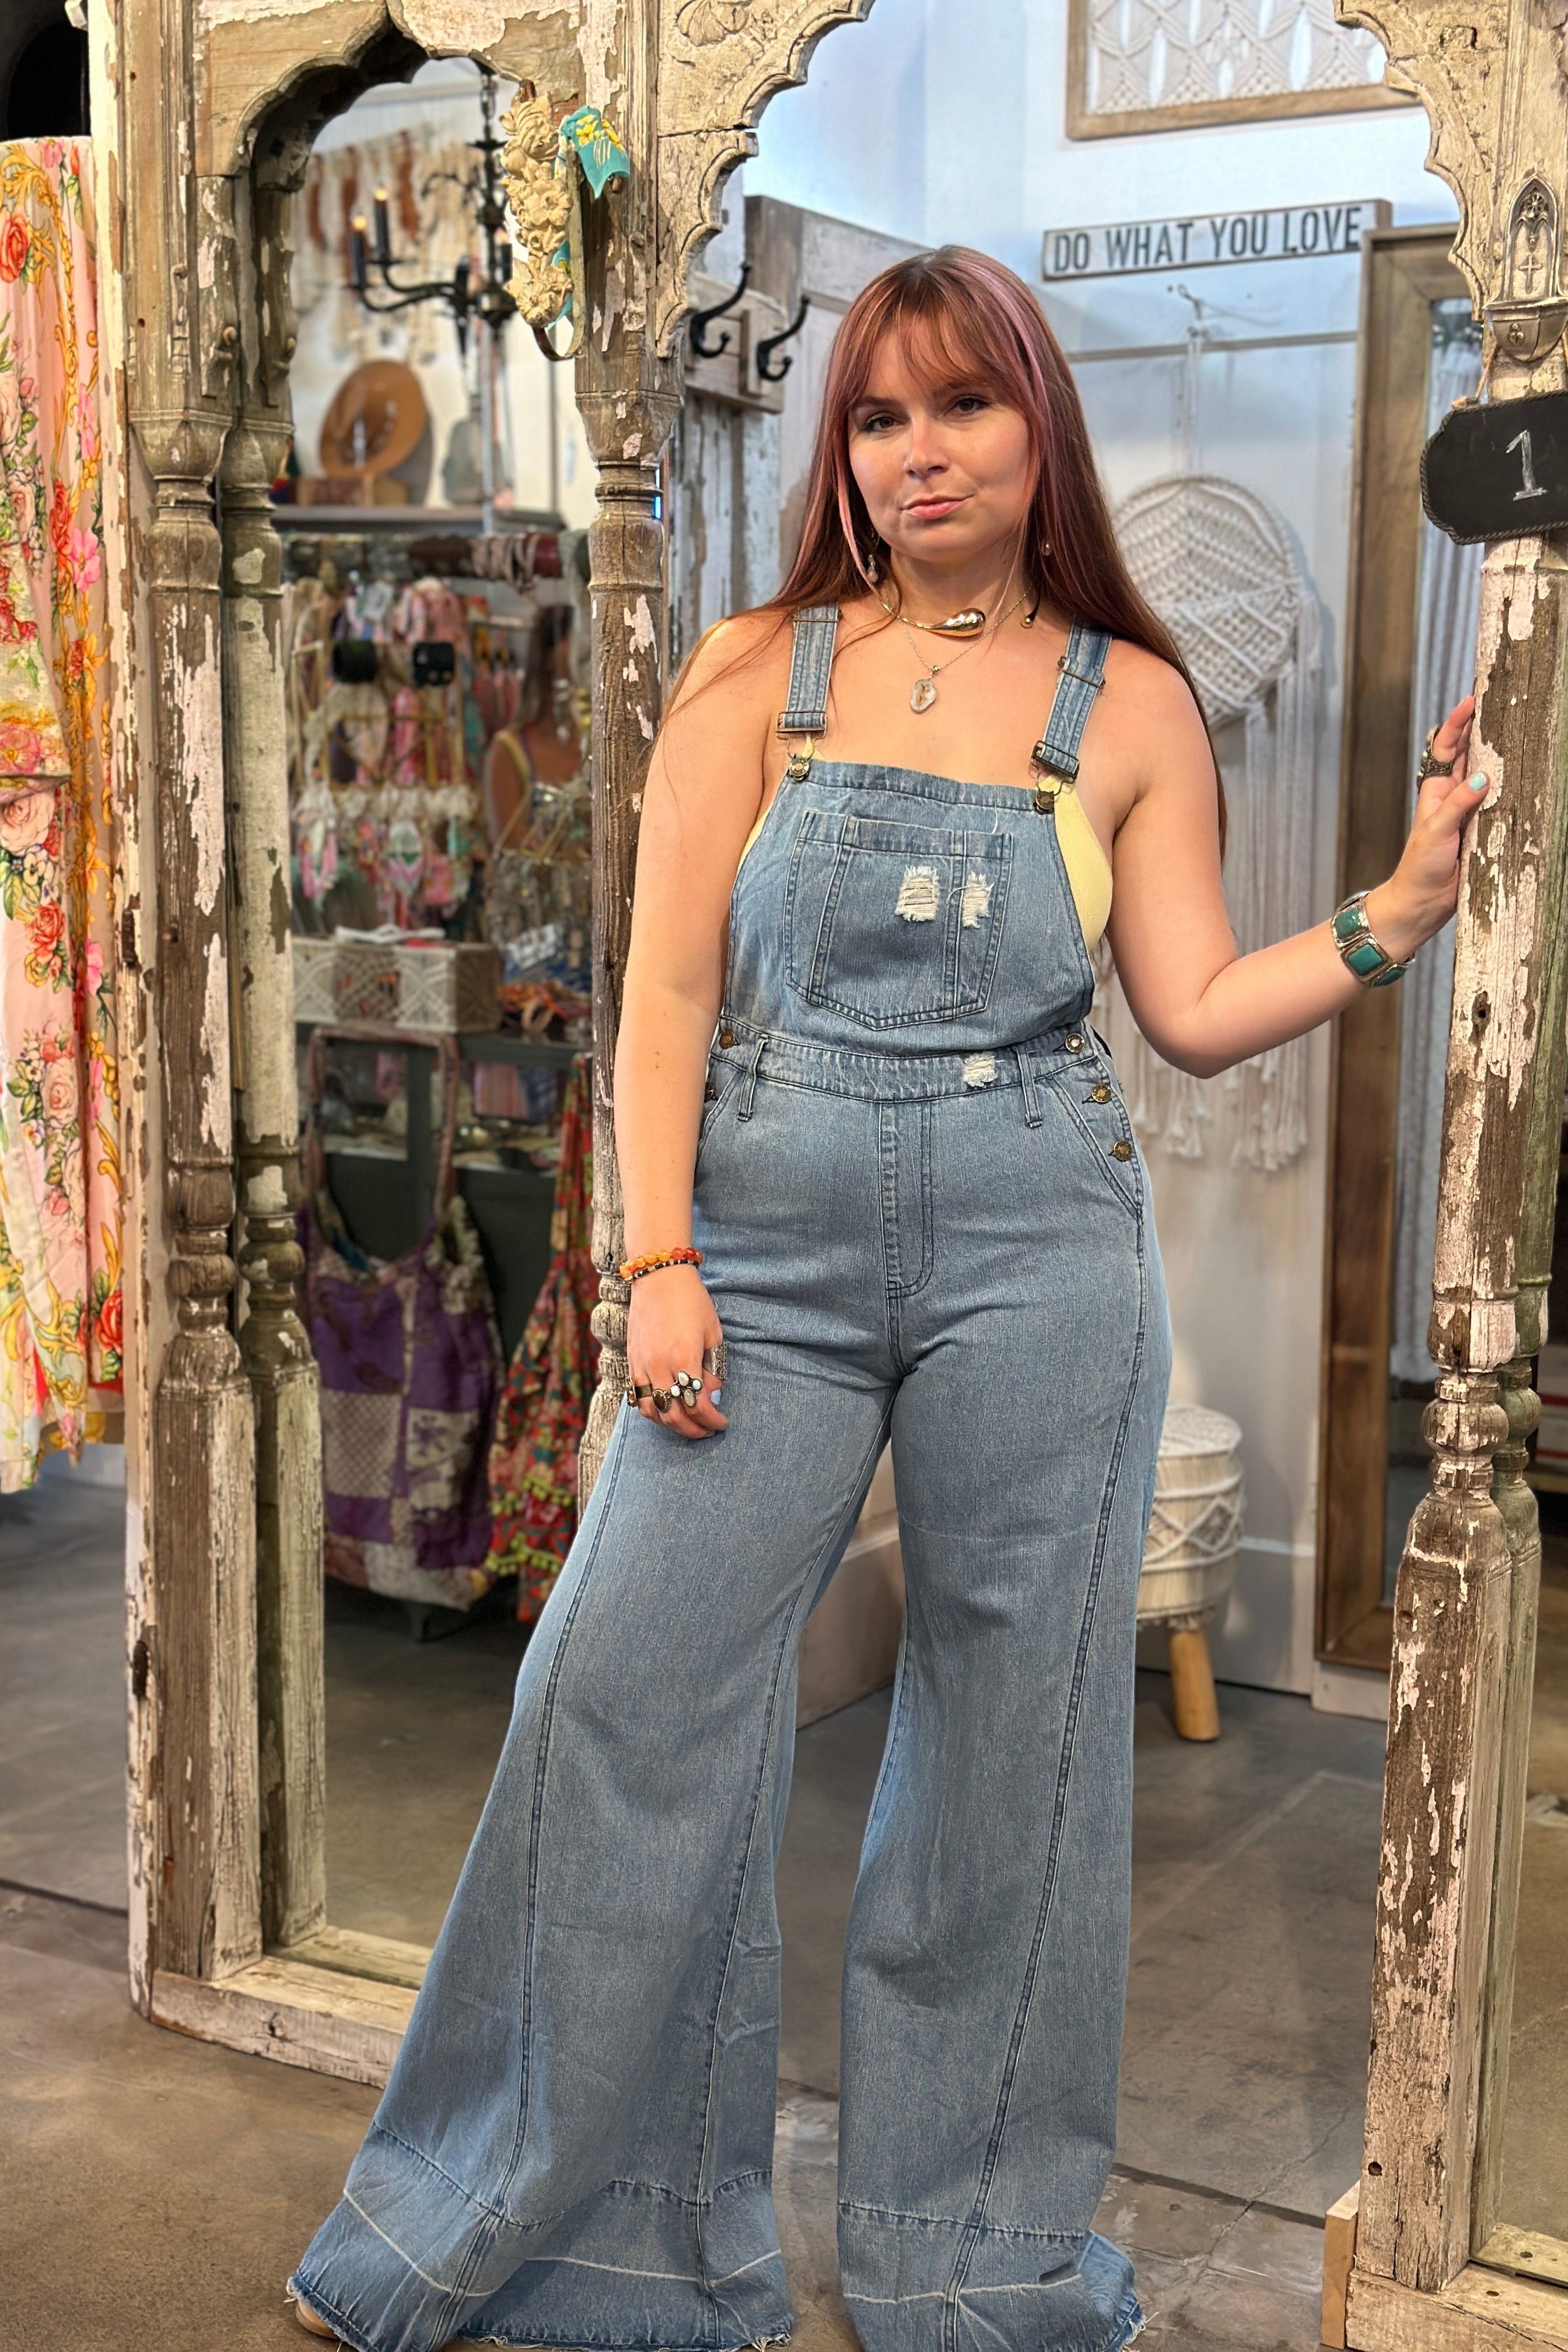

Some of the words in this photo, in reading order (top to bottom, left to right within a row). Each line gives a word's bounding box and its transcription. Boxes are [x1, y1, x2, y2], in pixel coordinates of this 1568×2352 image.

[1054, 233, 1090, 272] DO
[1106, 222, 1194, 269] WHAT
[1210, 214, 1268, 257] YOU
[1283, 206, 1363, 254] LOVE
[1505, 429, 1549, 502] 1
